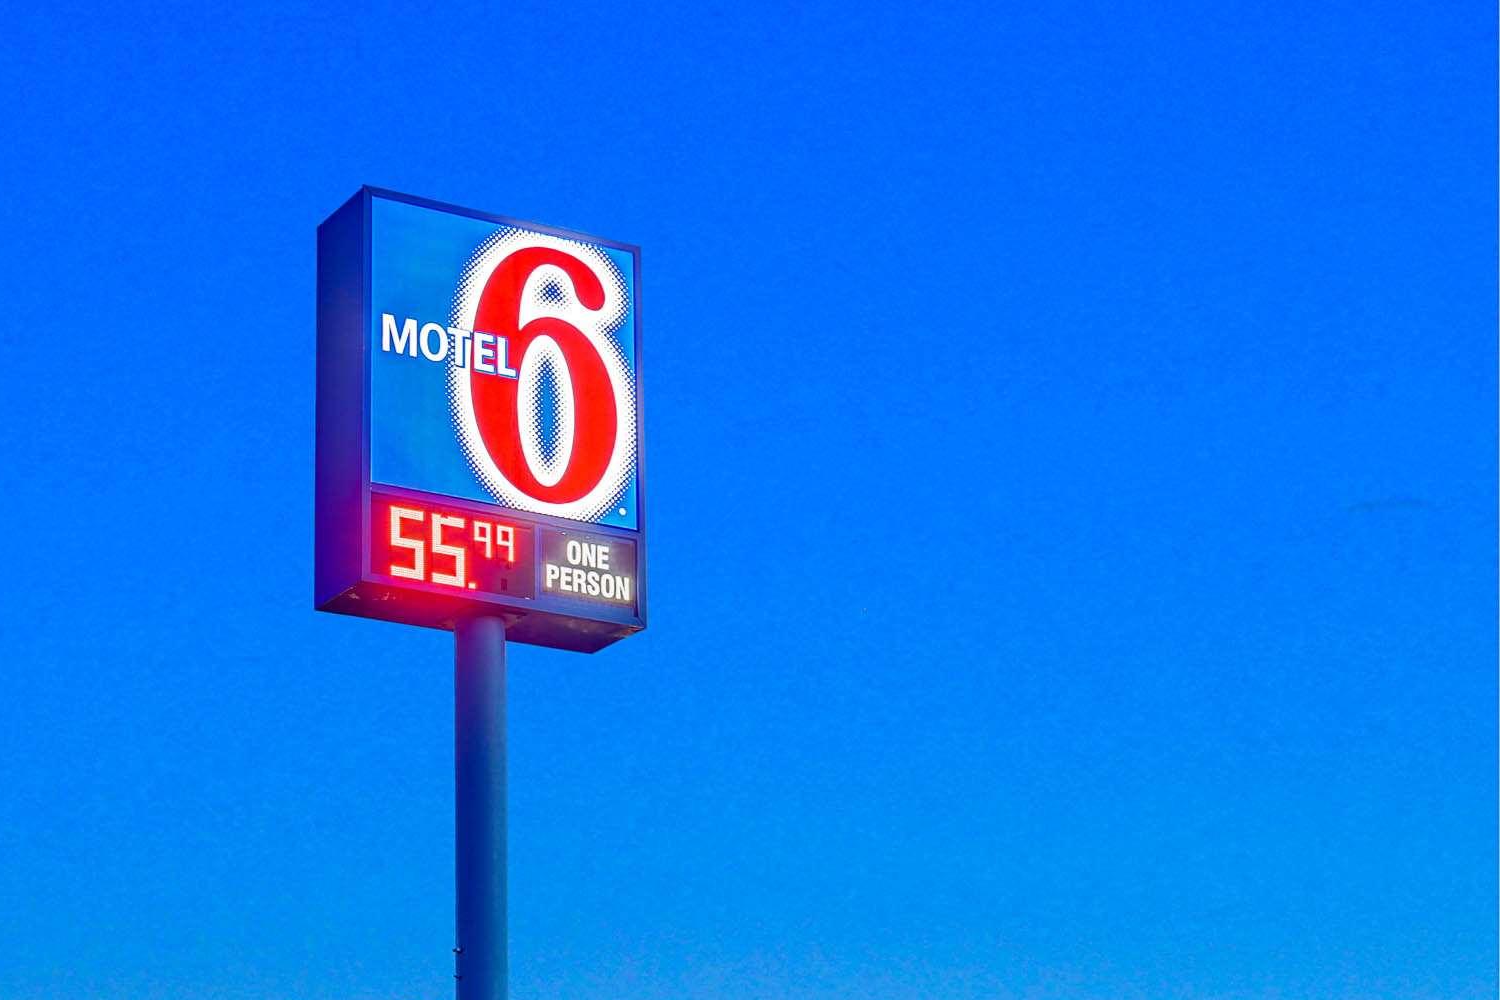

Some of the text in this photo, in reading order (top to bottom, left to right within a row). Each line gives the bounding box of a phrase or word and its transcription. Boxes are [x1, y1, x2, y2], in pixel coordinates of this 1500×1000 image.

[382, 245, 618, 505] MOTEL 6
[566, 540, 610, 571] ONE
[545, 563, 630, 601] PERSON
